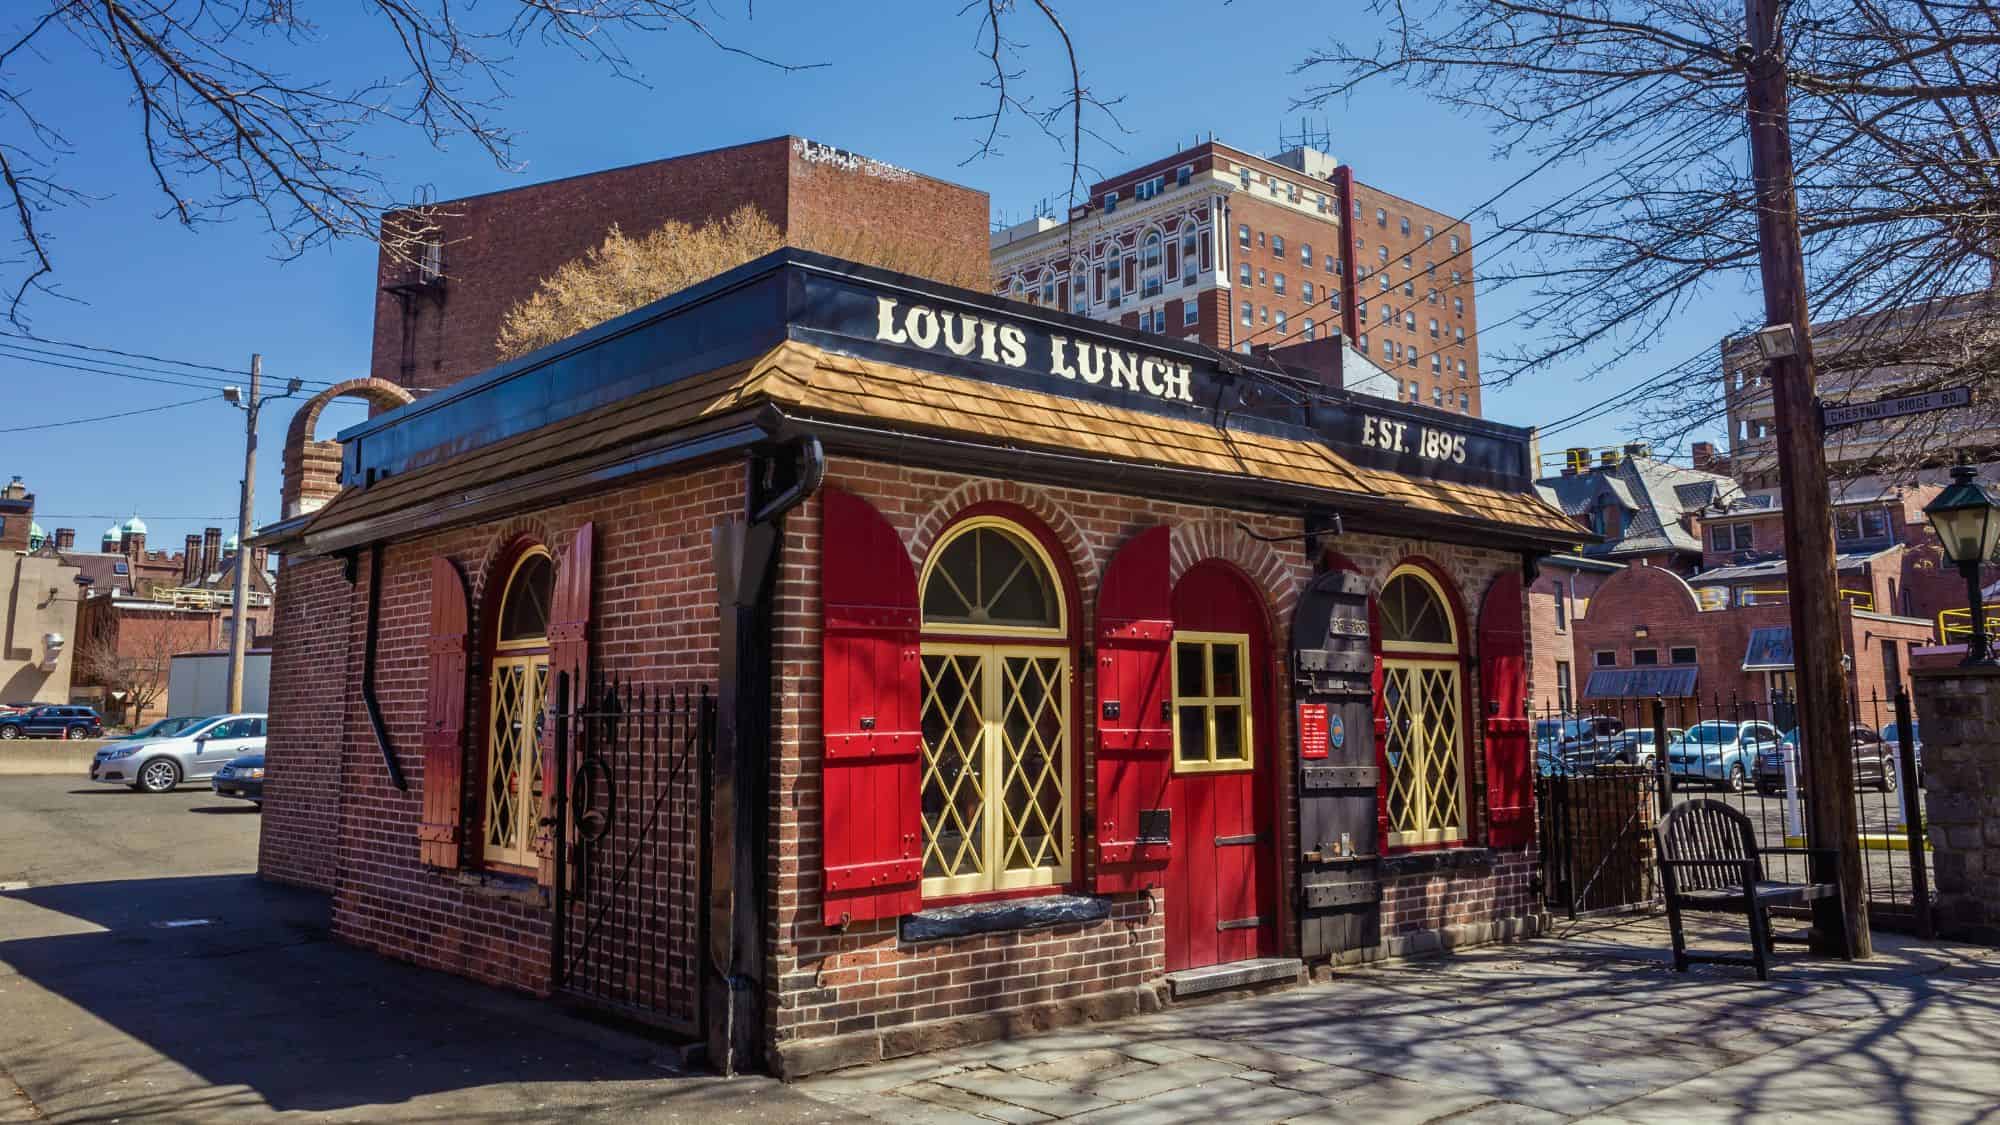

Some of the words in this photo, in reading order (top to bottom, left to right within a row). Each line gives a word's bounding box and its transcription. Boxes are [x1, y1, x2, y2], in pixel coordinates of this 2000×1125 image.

[876, 296, 1027, 368] LOUIS
[1050, 335, 1193, 402] LUNCH
[1831, 403, 1888, 423] CHESTNUT
[1897, 396, 1930, 413] RIDGE
[1362, 414, 1409, 453] EST.
[1418, 426, 1466, 463] 1895
